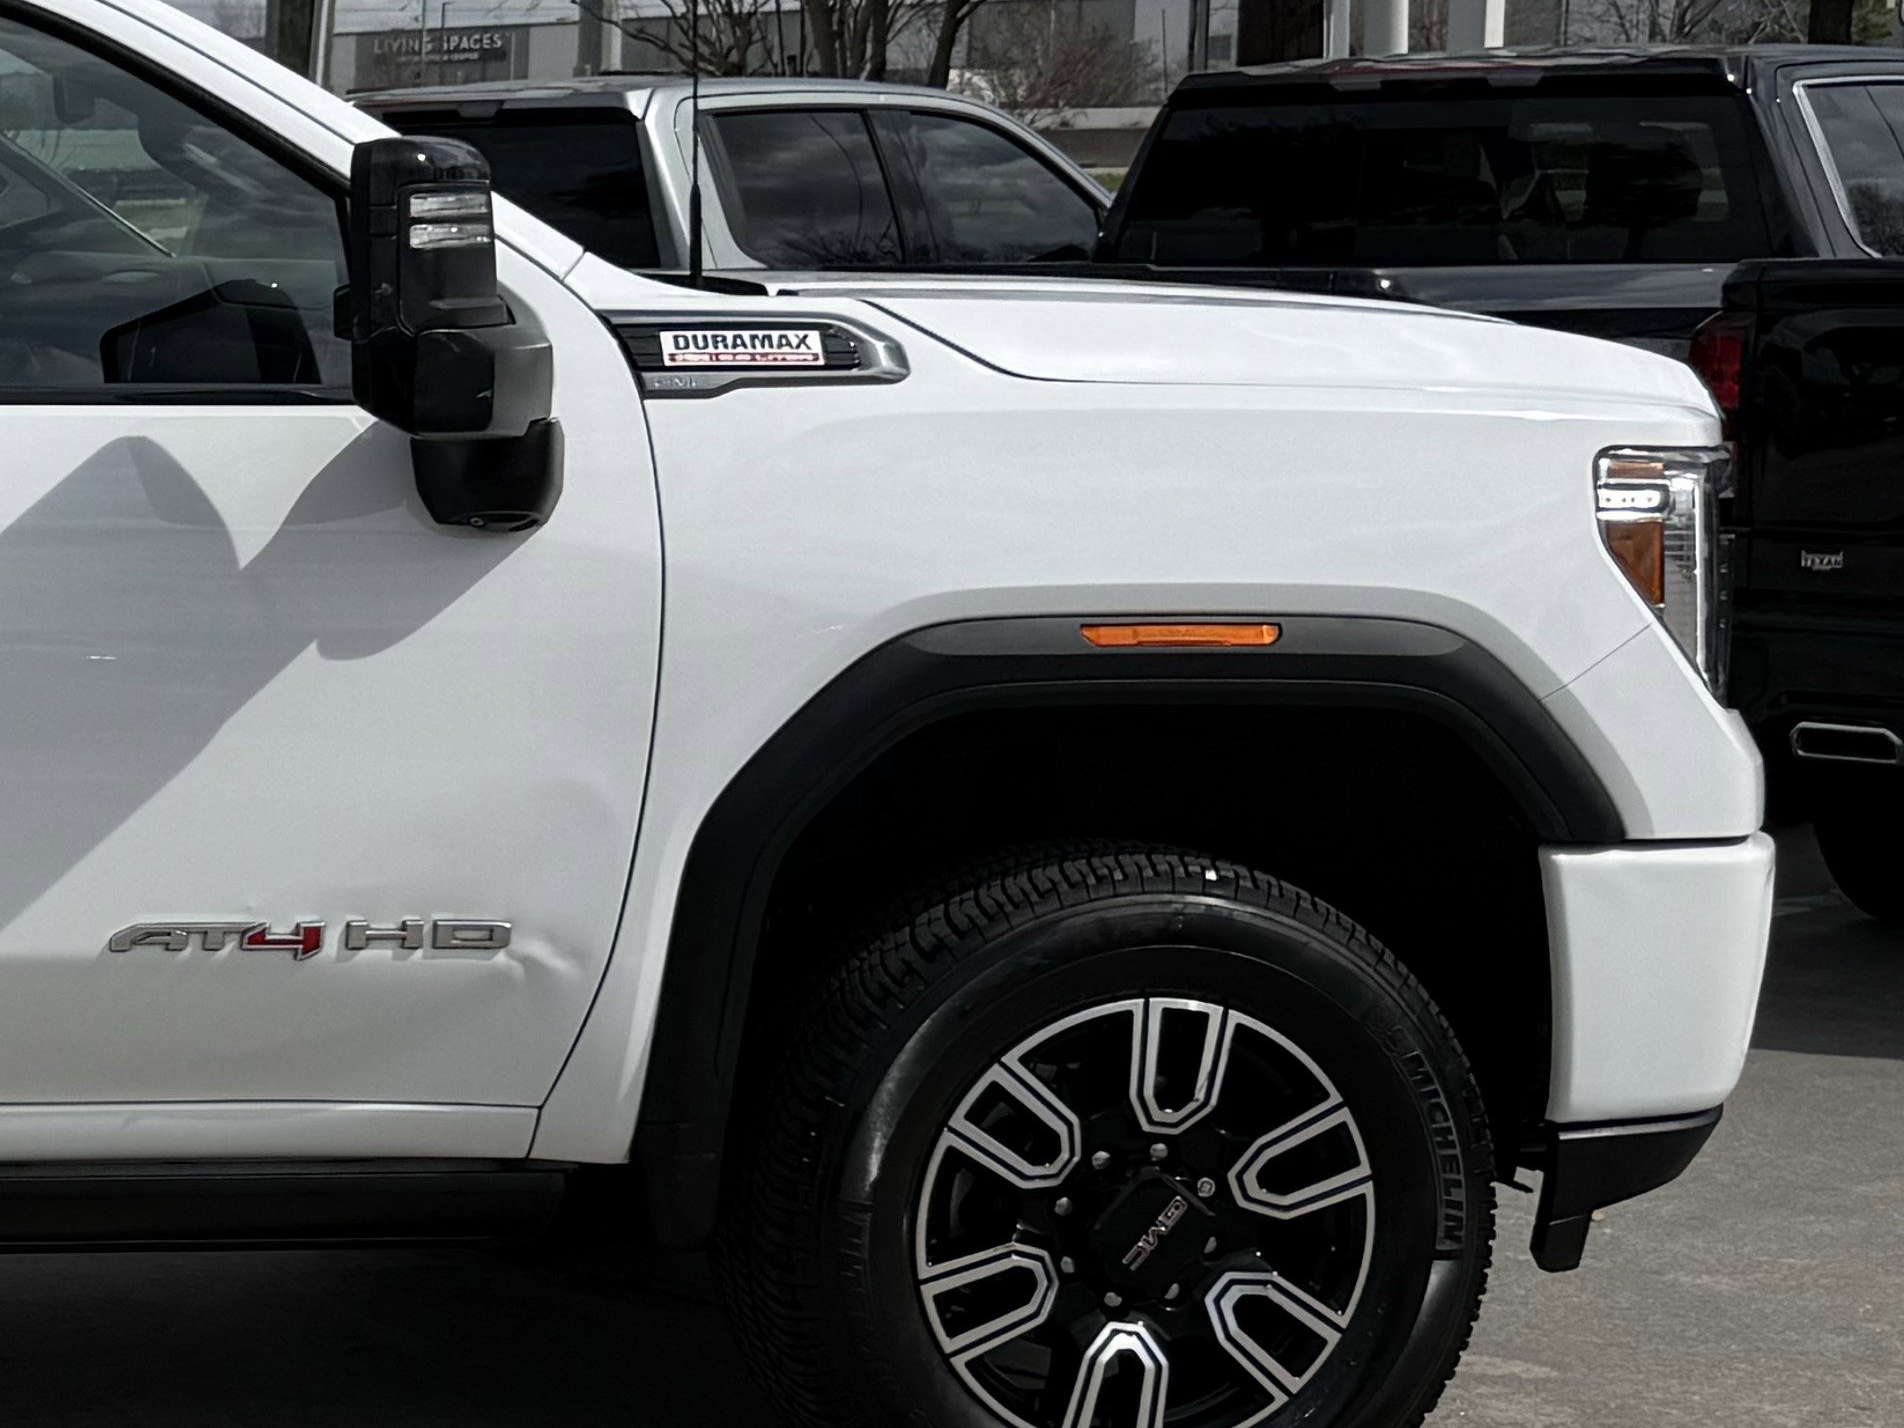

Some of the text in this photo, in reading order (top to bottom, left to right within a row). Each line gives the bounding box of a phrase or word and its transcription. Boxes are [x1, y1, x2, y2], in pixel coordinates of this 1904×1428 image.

[672, 333, 812, 351] DURAMAX
[110, 918, 513, 962] AT4 HD
[1398, 1050, 1465, 1245] MICHELIN
[1121, 1195, 1189, 1271] GMC
